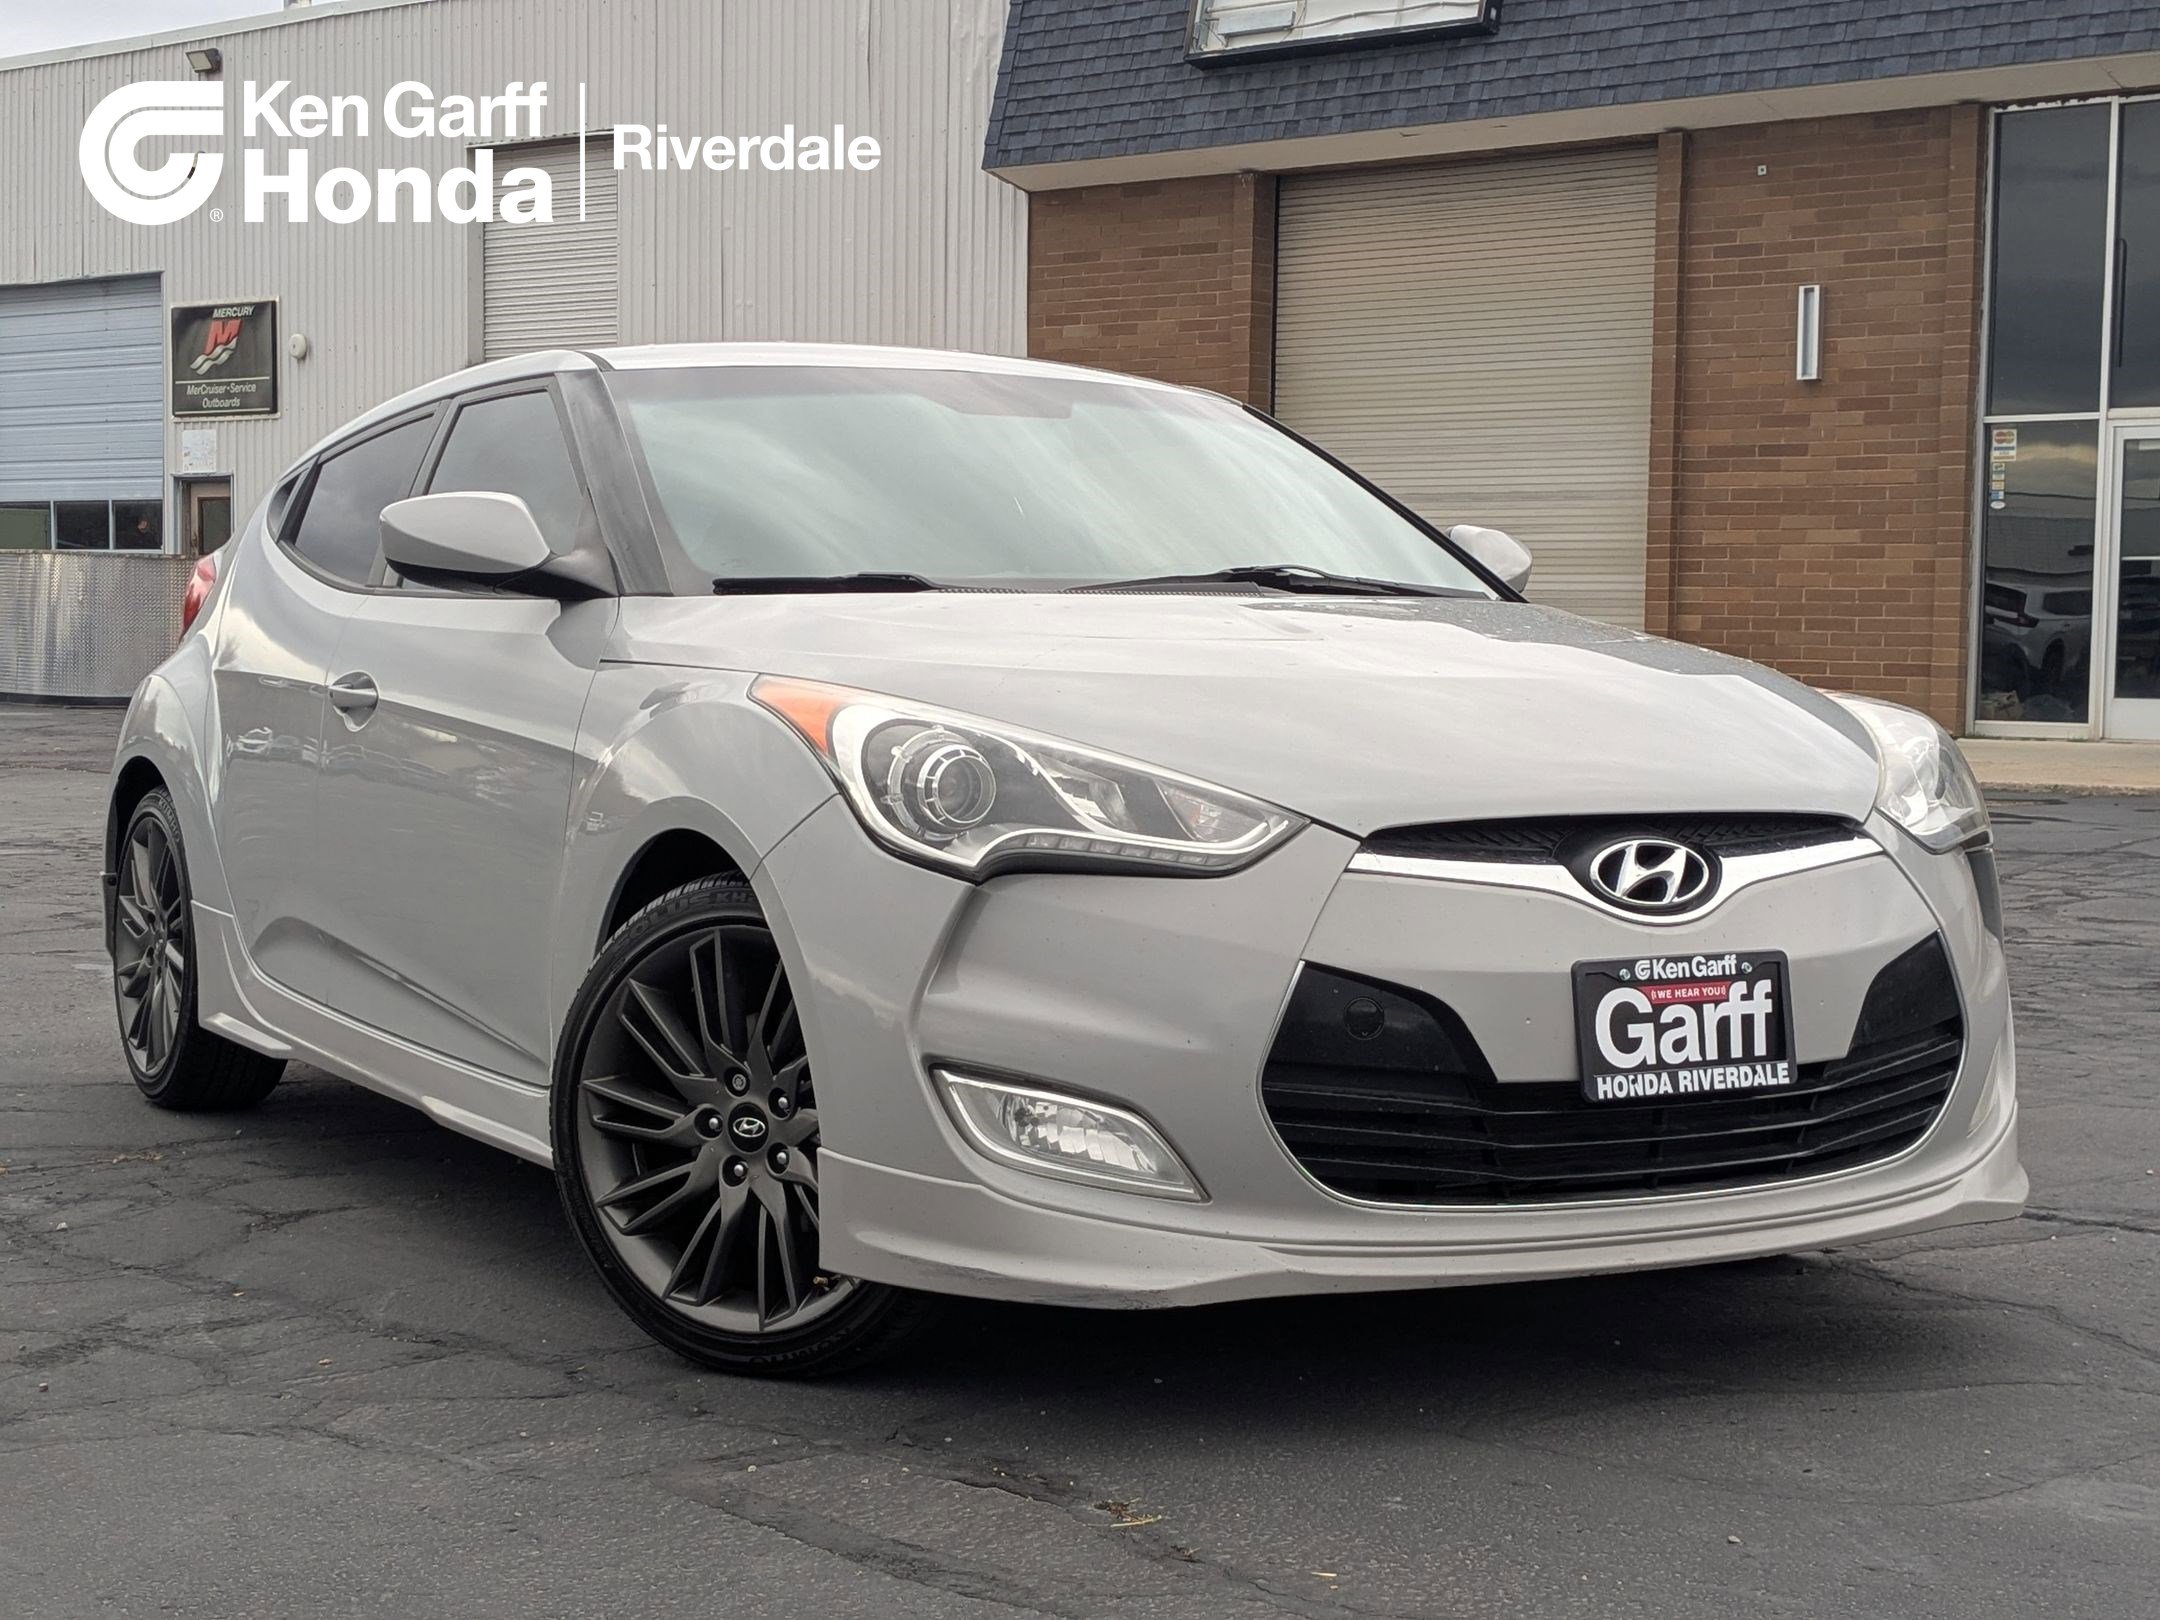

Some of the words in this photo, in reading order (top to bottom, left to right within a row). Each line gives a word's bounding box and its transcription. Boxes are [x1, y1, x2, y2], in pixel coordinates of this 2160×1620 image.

[212, 306, 255, 318] MERCURY
[202, 397, 240, 408] Outboards
[1652, 959, 1690, 979] Ken
[1691, 954, 1737, 977] Garff
[1657, 989, 1672, 999] WE
[1675, 988, 1700, 998] HEAR
[1702, 986, 1720, 995] YOU
[1595, 979, 1773, 1069] Garff
[1597, 1071, 1674, 1100] HONDA
[1678, 1062, 1790, 1094] RIVERDALE
